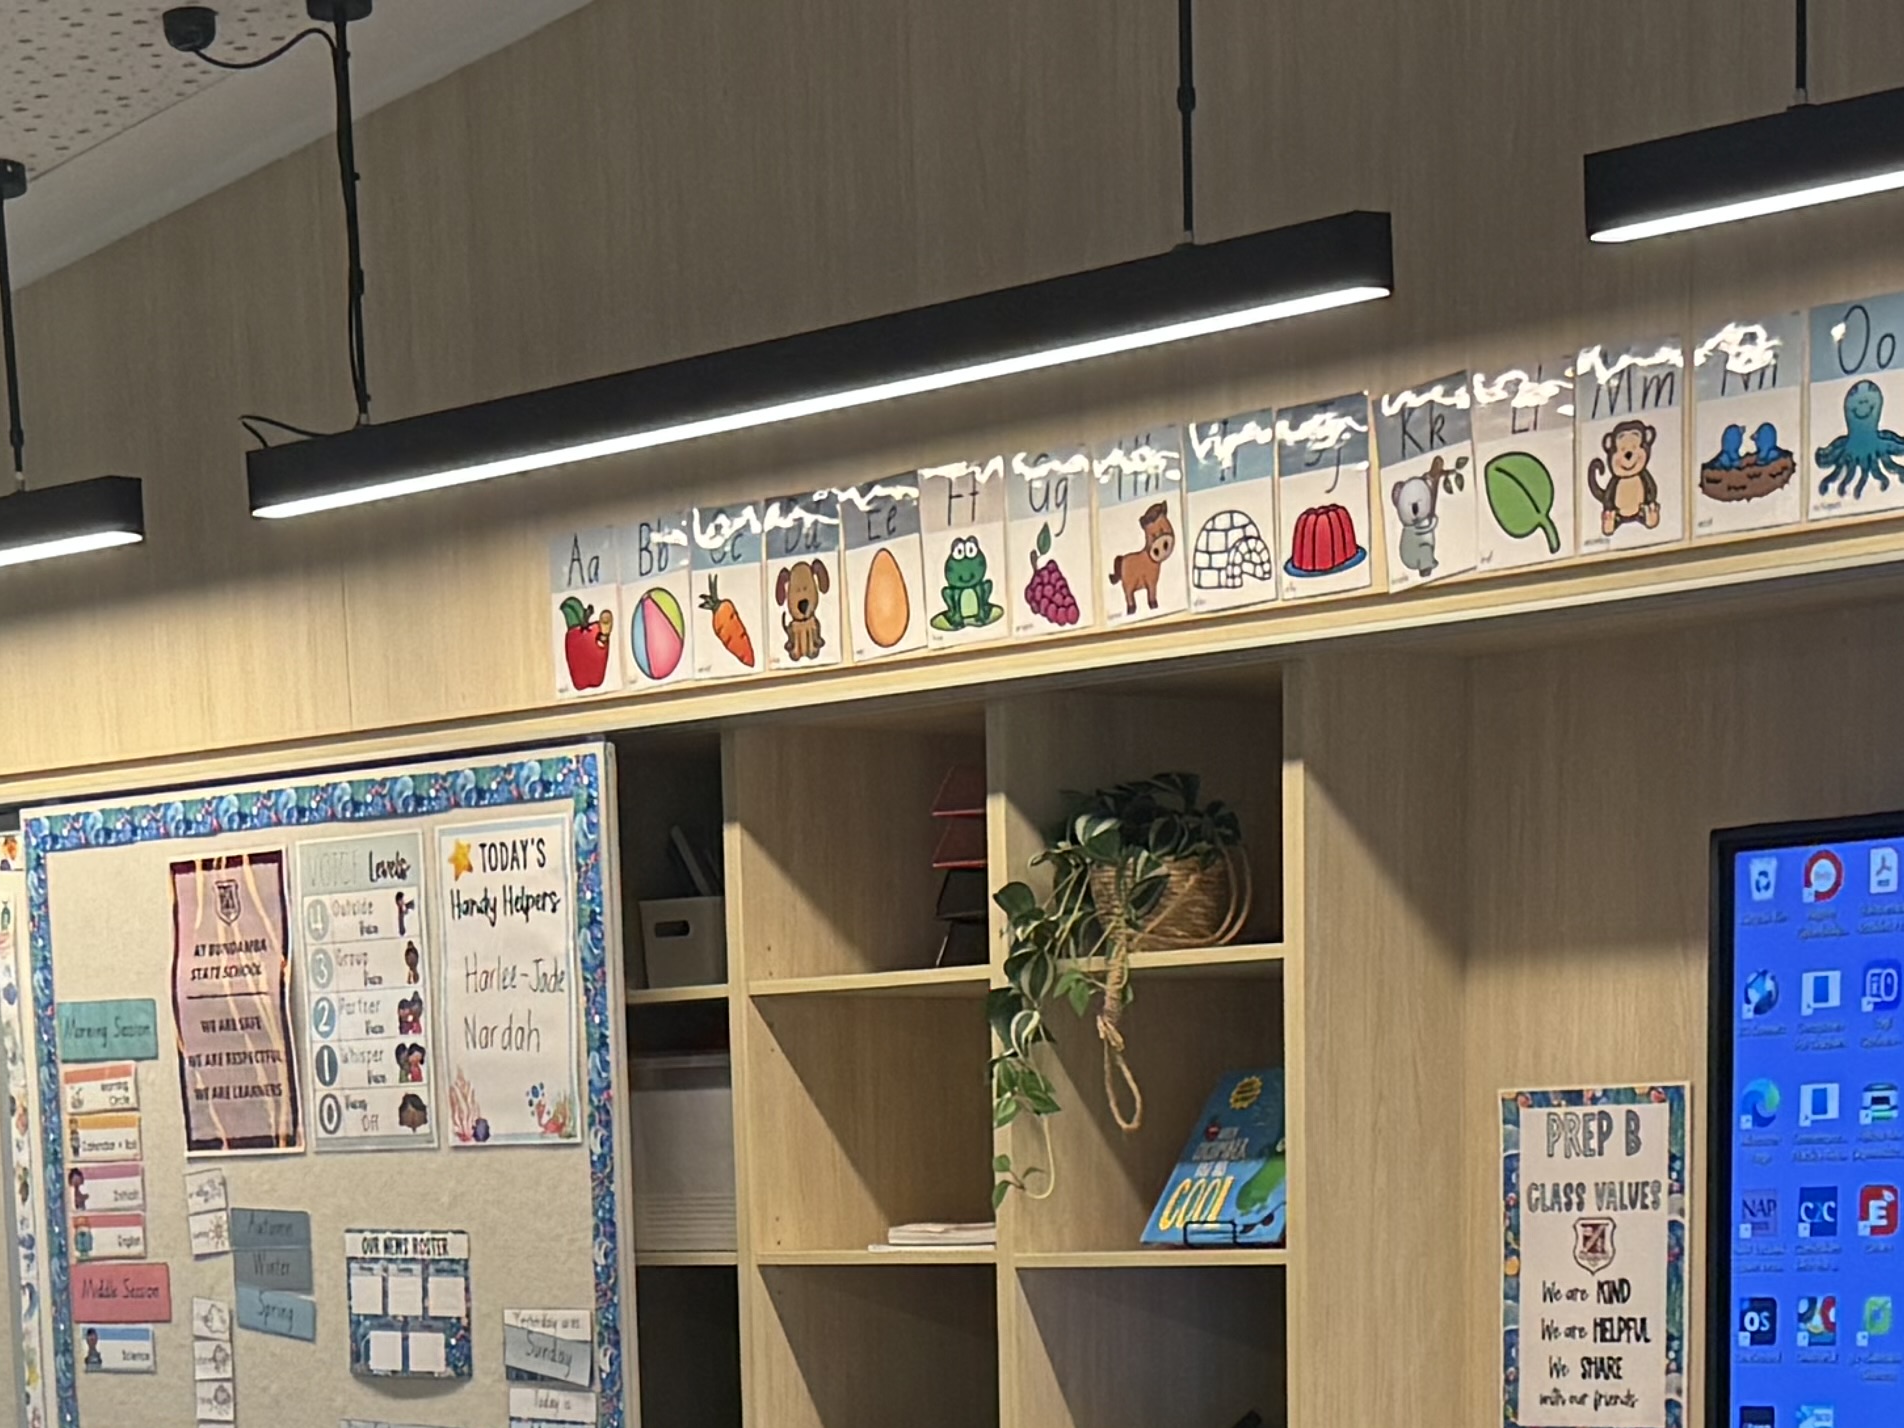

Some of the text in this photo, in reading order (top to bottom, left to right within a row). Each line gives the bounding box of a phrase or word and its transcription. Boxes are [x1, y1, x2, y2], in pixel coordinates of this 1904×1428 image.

[1838, 304, 1896, 375] Oo
[1592, 350, 1675, 419] Mm
[567, 532, 600, 587] Aa
[638, 519, 669, 577] Bb
[479, 838, 548, 874] TODAY'S
[312, 904, 327, 935] 4
[450, 886, 561, 927] Handy Helpers
[191, 963, 263, 981] STATE SCHOOL
[315, 951, 330, 982] 3
[464, 951, 567, 995] Harlee-Jade
[201, 1019, 215, 1031] WE
[217, 1018, 236, 1031] ARE
[317, 1002, 333, 1034] 2
[194, 1087, 211, 1100] WE
[213, 1086, 231, 1100] ARE
[1545, 1109, 1643, 1159] PREP B
[1526, 1179, 1664, 1214] CLASS VALUES
[1742, 1196, 1778, 1218] NAP
[362, 1236, 449, 1257] OUR NEWS ROSTER
[254, 1254, 291, 1277] Winter
[1542, 1278, 1631, 1305] We are KIND
[258, 1292, 295, 1326] Spring
[1744, 1310, 1771, 1332] OS
[1541, 1316, 1652, 1344] We are HELPFUL
[526, 1329, 573, 1379] Sunday
[1548, 1355, 1624, 1381] We SHARE
